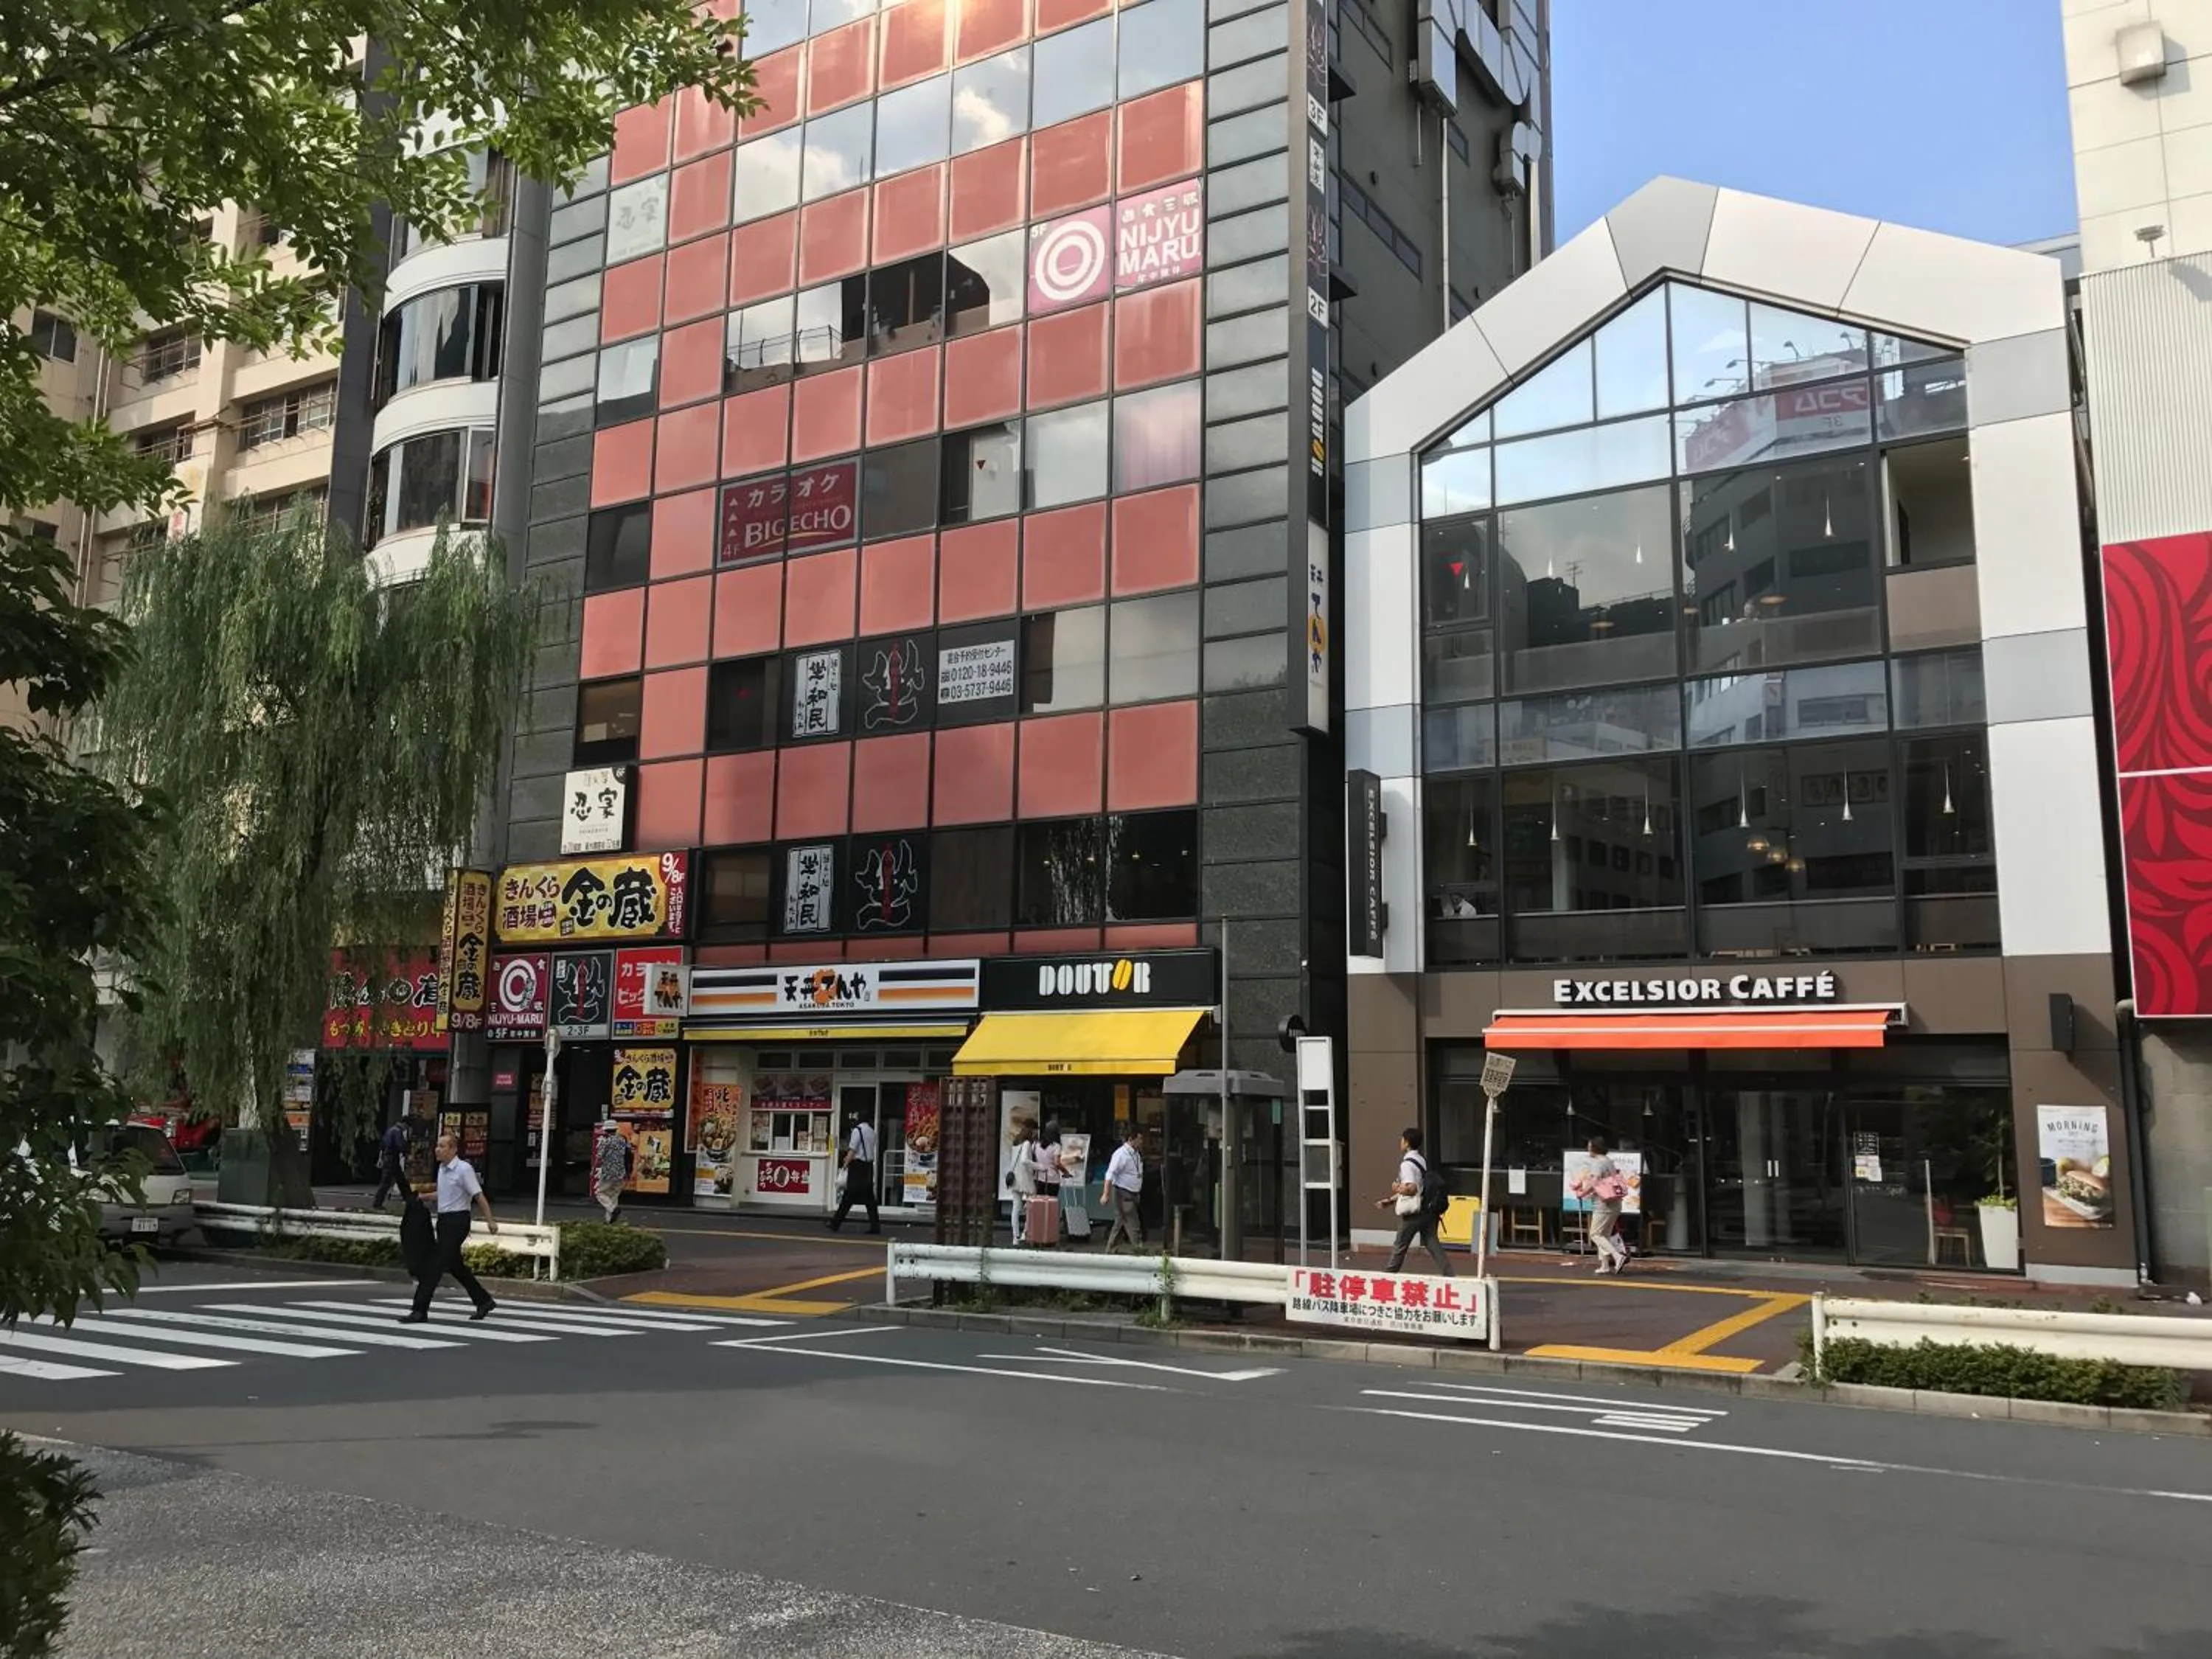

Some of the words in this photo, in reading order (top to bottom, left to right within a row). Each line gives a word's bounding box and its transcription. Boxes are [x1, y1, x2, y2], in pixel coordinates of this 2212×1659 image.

[1310, 100, 1323, 122] 3F
[1119, 208, 1200, 251] NIJYU
[1119, 234, 1202, 276] MARU
[1310, 295, 1324, 319] 2F
[1312, 367, 1325, 477] DOUTOR
[748, 473, 839, 508] カラオケ
[745, 518, 786, 548] BIG
[790, 504, 852, 532] ECHO
[570, 787, 618, 821] 忍家
[1368, 789, 1376, 880] EXCELSIOR
[505, 876, 560, 901] きんくら
[562, 866, 658, 930] 金の蔵
[502, 905, 537, 930] 酒場
[784, 971, 867, 1001] 天丼てんや
[1039, 959, 1150, 996] DOUTOR
[1554, 977, 1721, 1002] EXCELSIOR
[1729, 970, 1836, 999] CAFFÉ
[451, 1012, 482, 1031] 9/8F
[616, 1065, 672, 1104] 金の蔵
[2046, 1120, 2099, 1133] MORNING
[1294, 1270, 1478, 1313] 「駐停車禁止」
